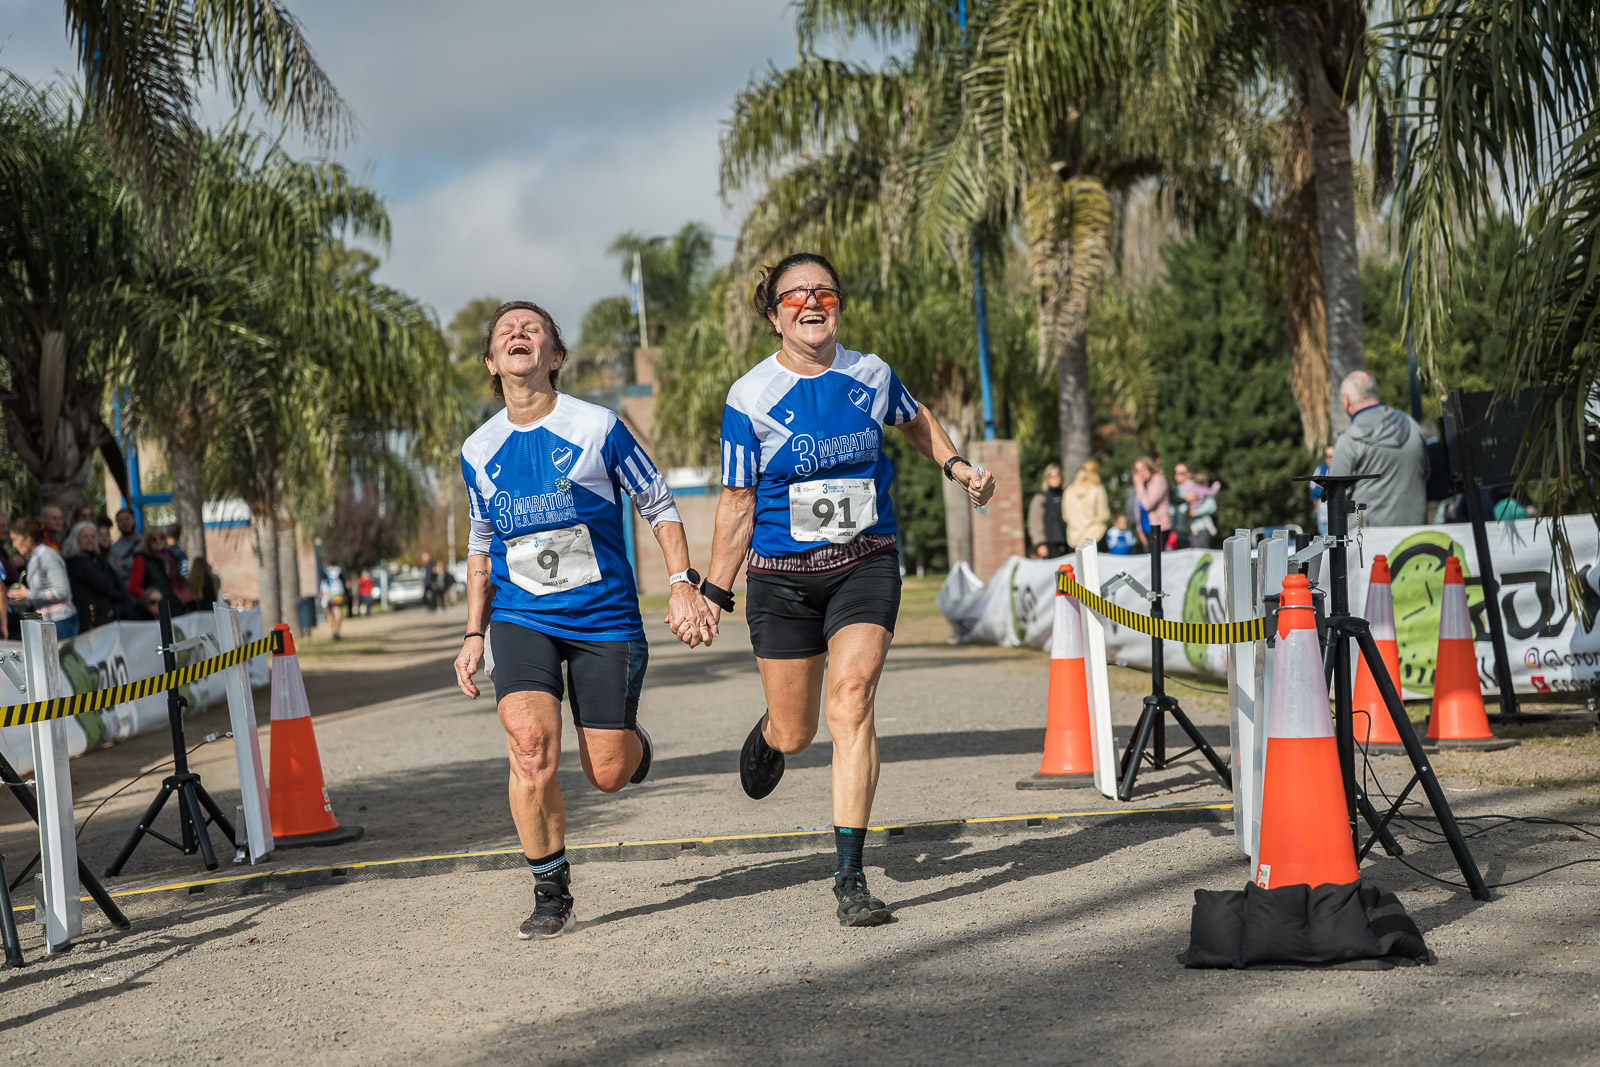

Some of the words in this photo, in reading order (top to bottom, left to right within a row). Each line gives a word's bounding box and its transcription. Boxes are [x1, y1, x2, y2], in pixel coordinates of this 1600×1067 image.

[792, 434, 818, 477] 3
[818, 427, 879, 458] MARATÓN
[495, 491, 513, 534] 3
[513, 490, 574, 515] MARATÓN
[812, 498, 856, 528] 91
[537, 550, 559, 578] 9
